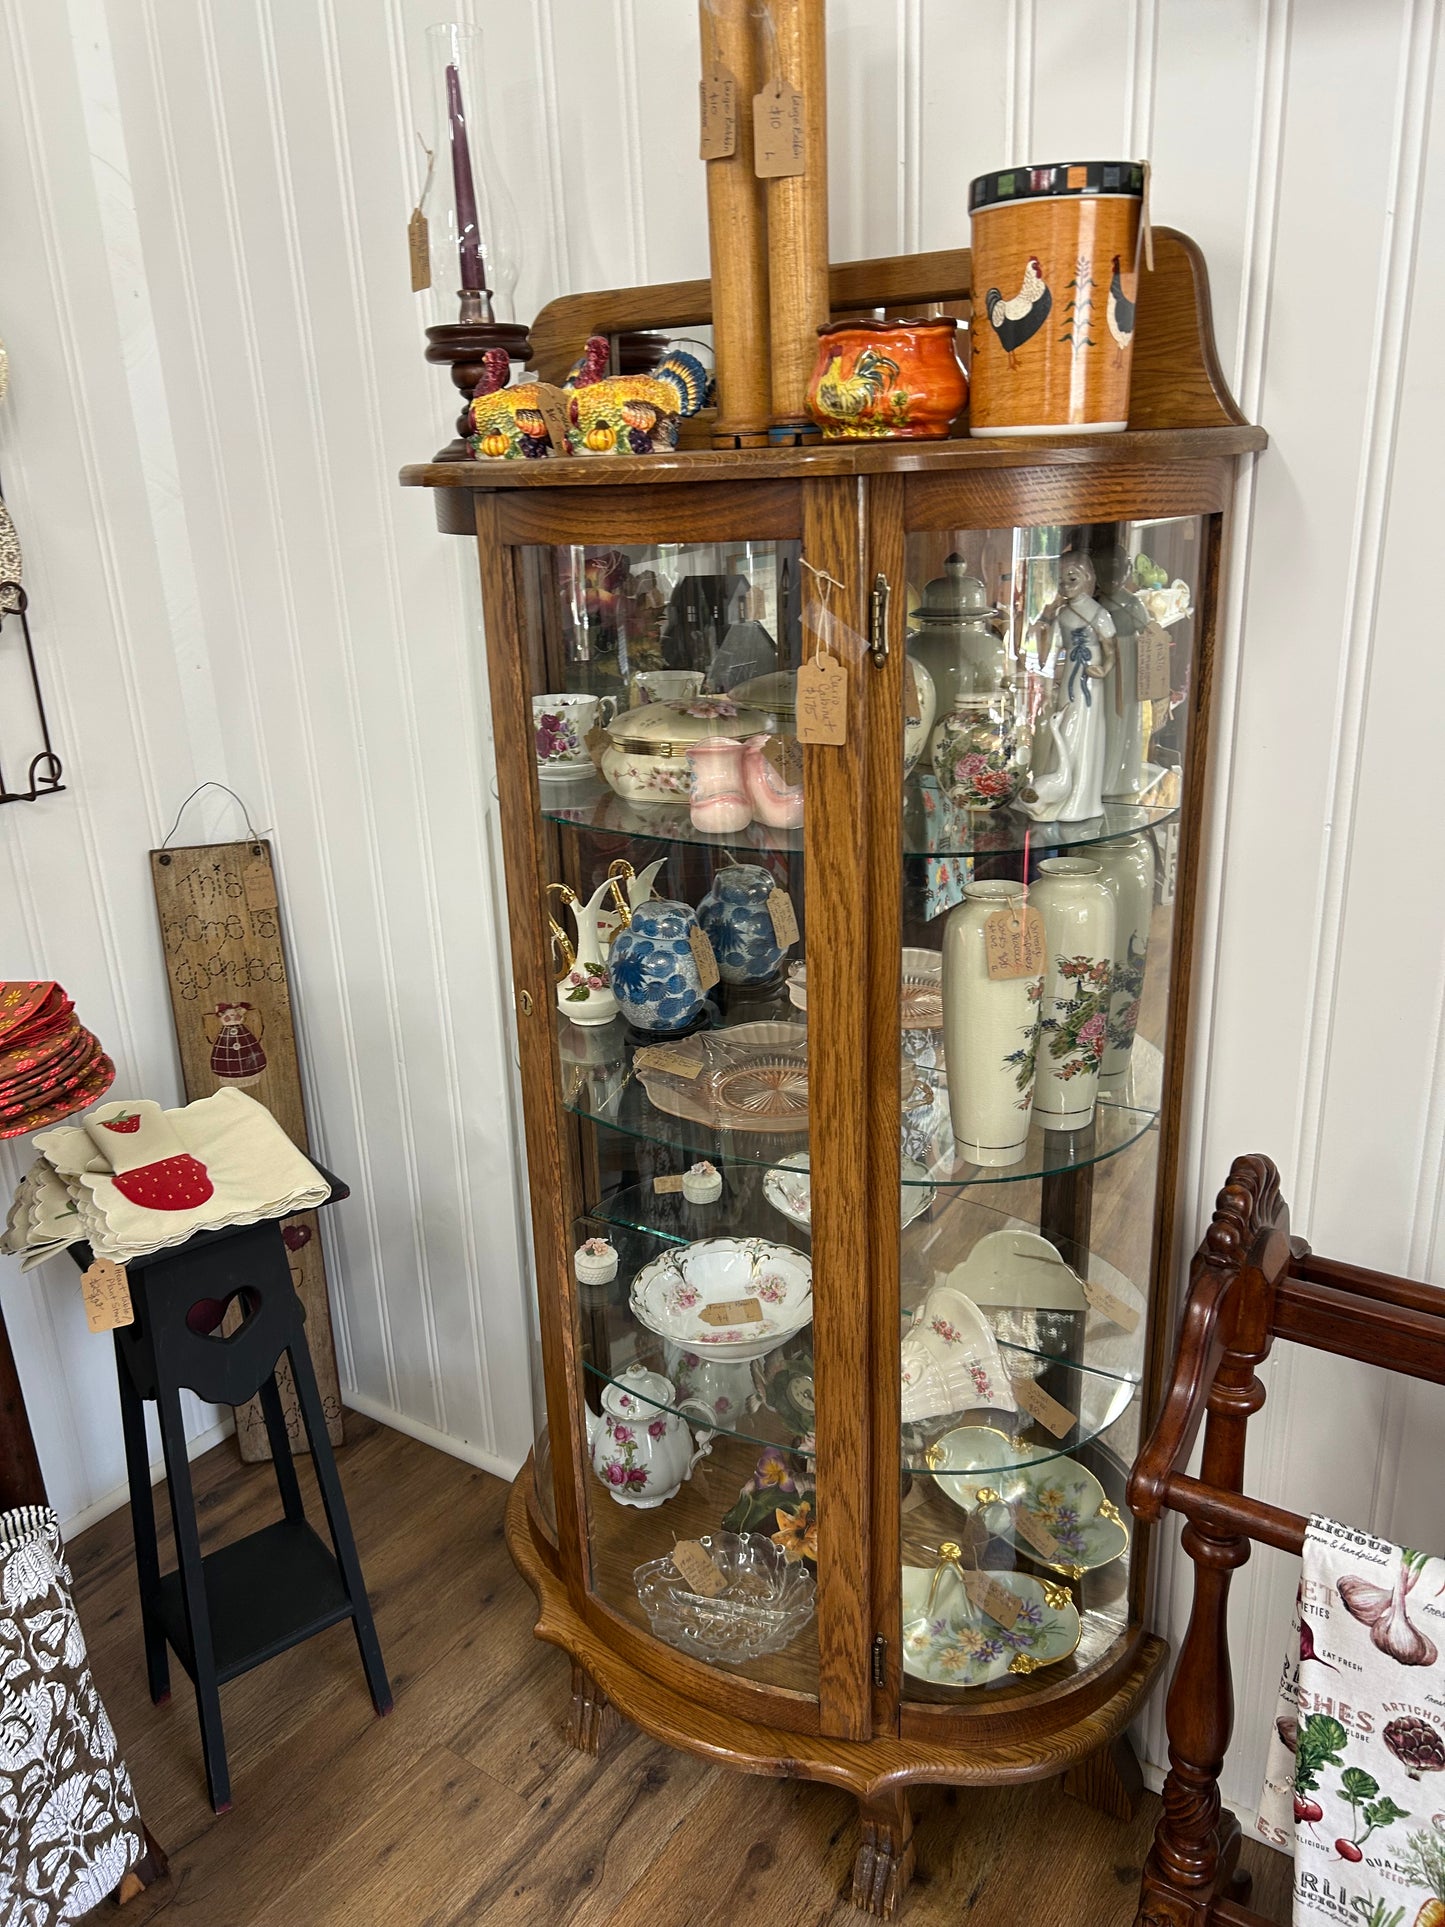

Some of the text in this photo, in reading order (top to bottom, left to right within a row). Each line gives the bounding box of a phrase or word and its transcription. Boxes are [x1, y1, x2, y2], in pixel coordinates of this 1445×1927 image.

[803, 687, 820, 721] $175
[829, 675, 843, 706] Curio
[175, 863, 244, 905] This
[162, 912, 245, 956] home
[106, 1278, 117, 1300] Plant
[115, 1268, 127, 1292] Heart
[1329, 1539, 1339, 1549] &
[1339, 1543, 1388, 1567] handpicked
[1322, 1650, 1363, 1673] EAT FRESH
